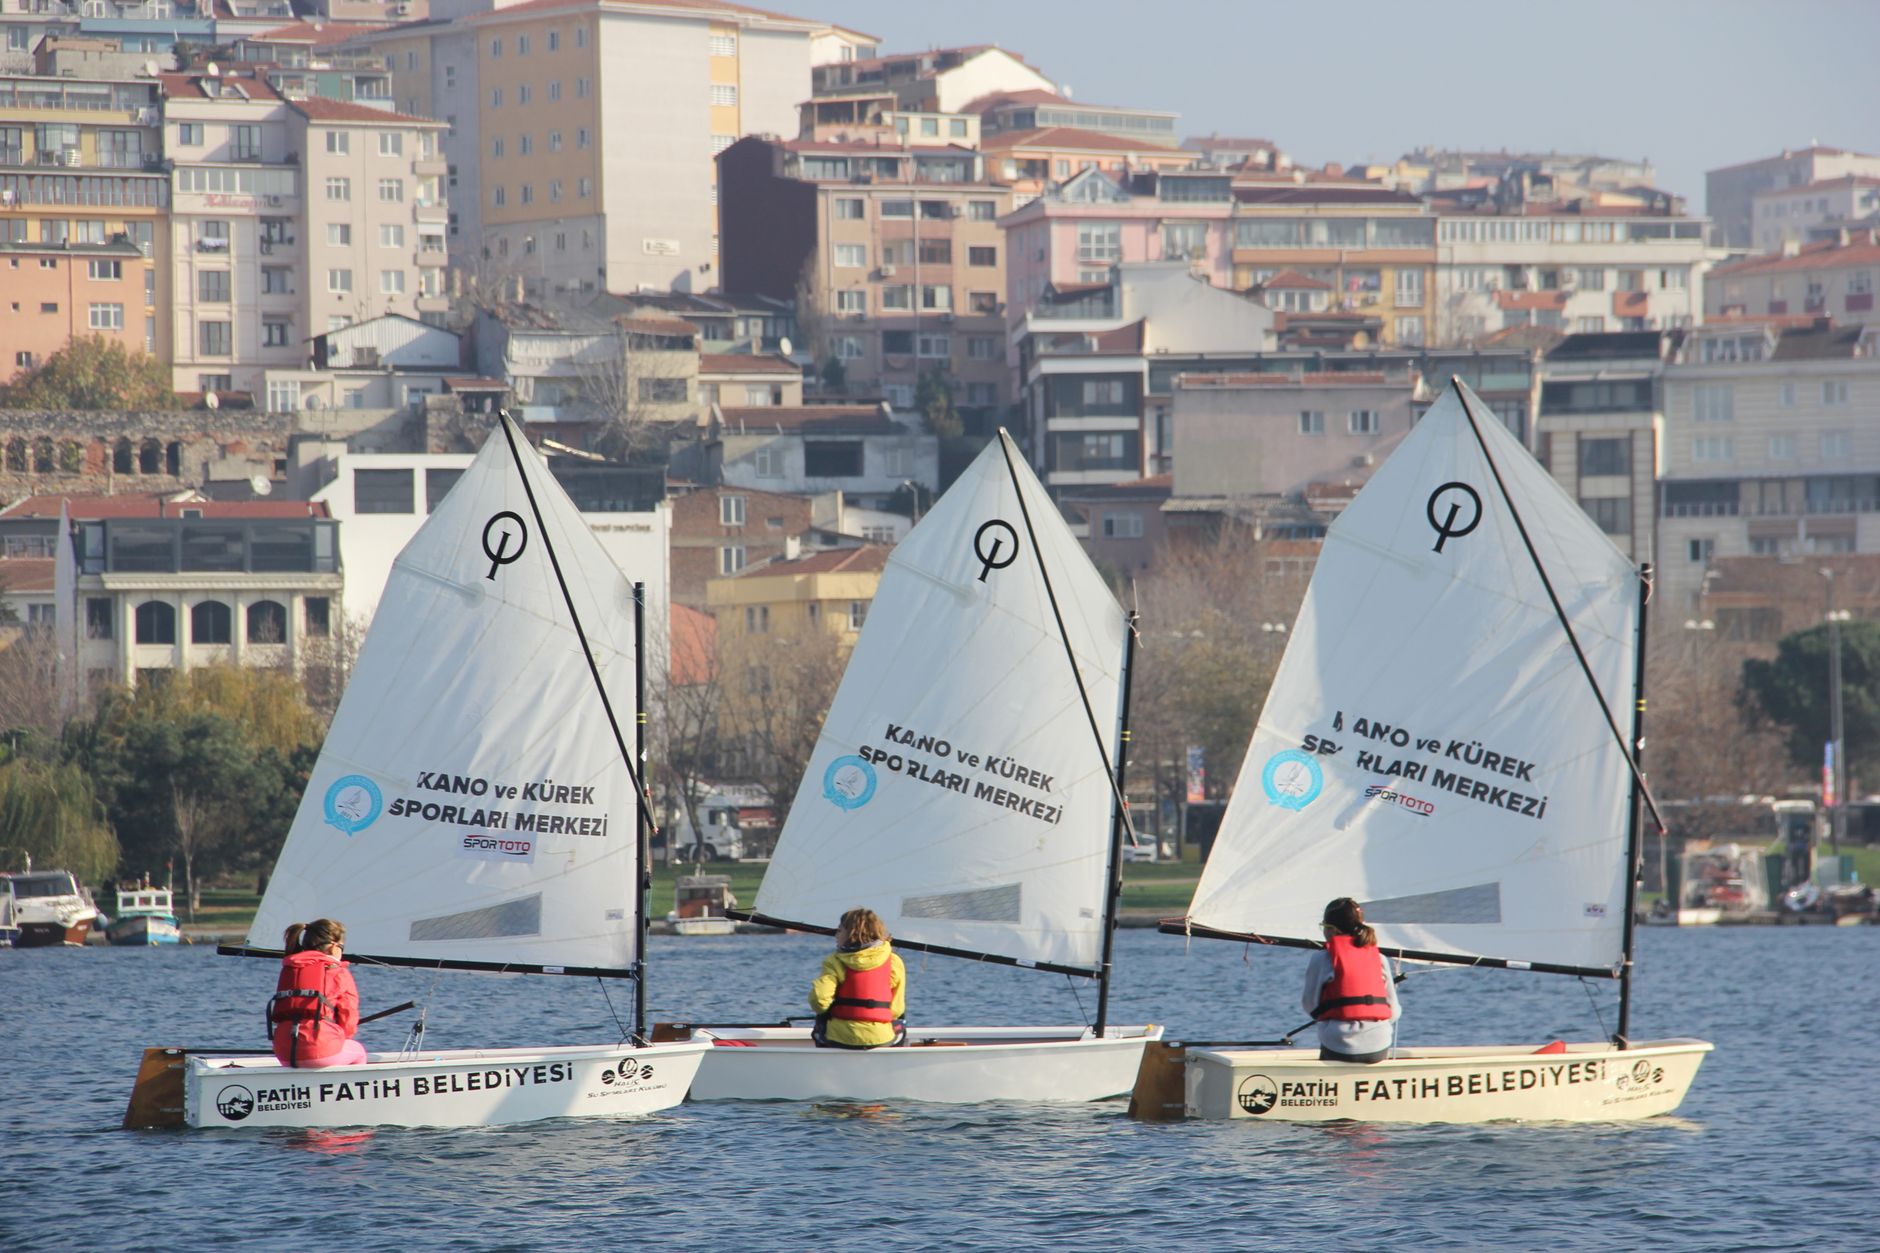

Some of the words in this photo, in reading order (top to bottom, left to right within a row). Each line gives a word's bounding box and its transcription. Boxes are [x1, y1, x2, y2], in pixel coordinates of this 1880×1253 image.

[885, 723, 952, 758] KANO
[957, 750, 980, 767] ve
[984, 756, 1055, 792] KÜREK
[1301, 734, 1428, 783] SPRLARI
[1431, 769, 1548, 820] MERKEZİ
[1416, 737, 1441, 754] ve
[1445, 740, 1536, 782] KÜREK
[417, 771, 488, 797] KANO
[495, 783, 517, 800] ve
[522, 779, 596, 805] KÜREK
[858, 745, 971, 795] SPORLARI
[974, 782, 1063, 825] MERKEZİ
[388, 798, 508, 830] SPORLARI
[515, 813, 608, 837] MERKEZİ
[257, 1084, 310, 1103] FATİH
[1282, 1078, 1338, 1097] FATİH
